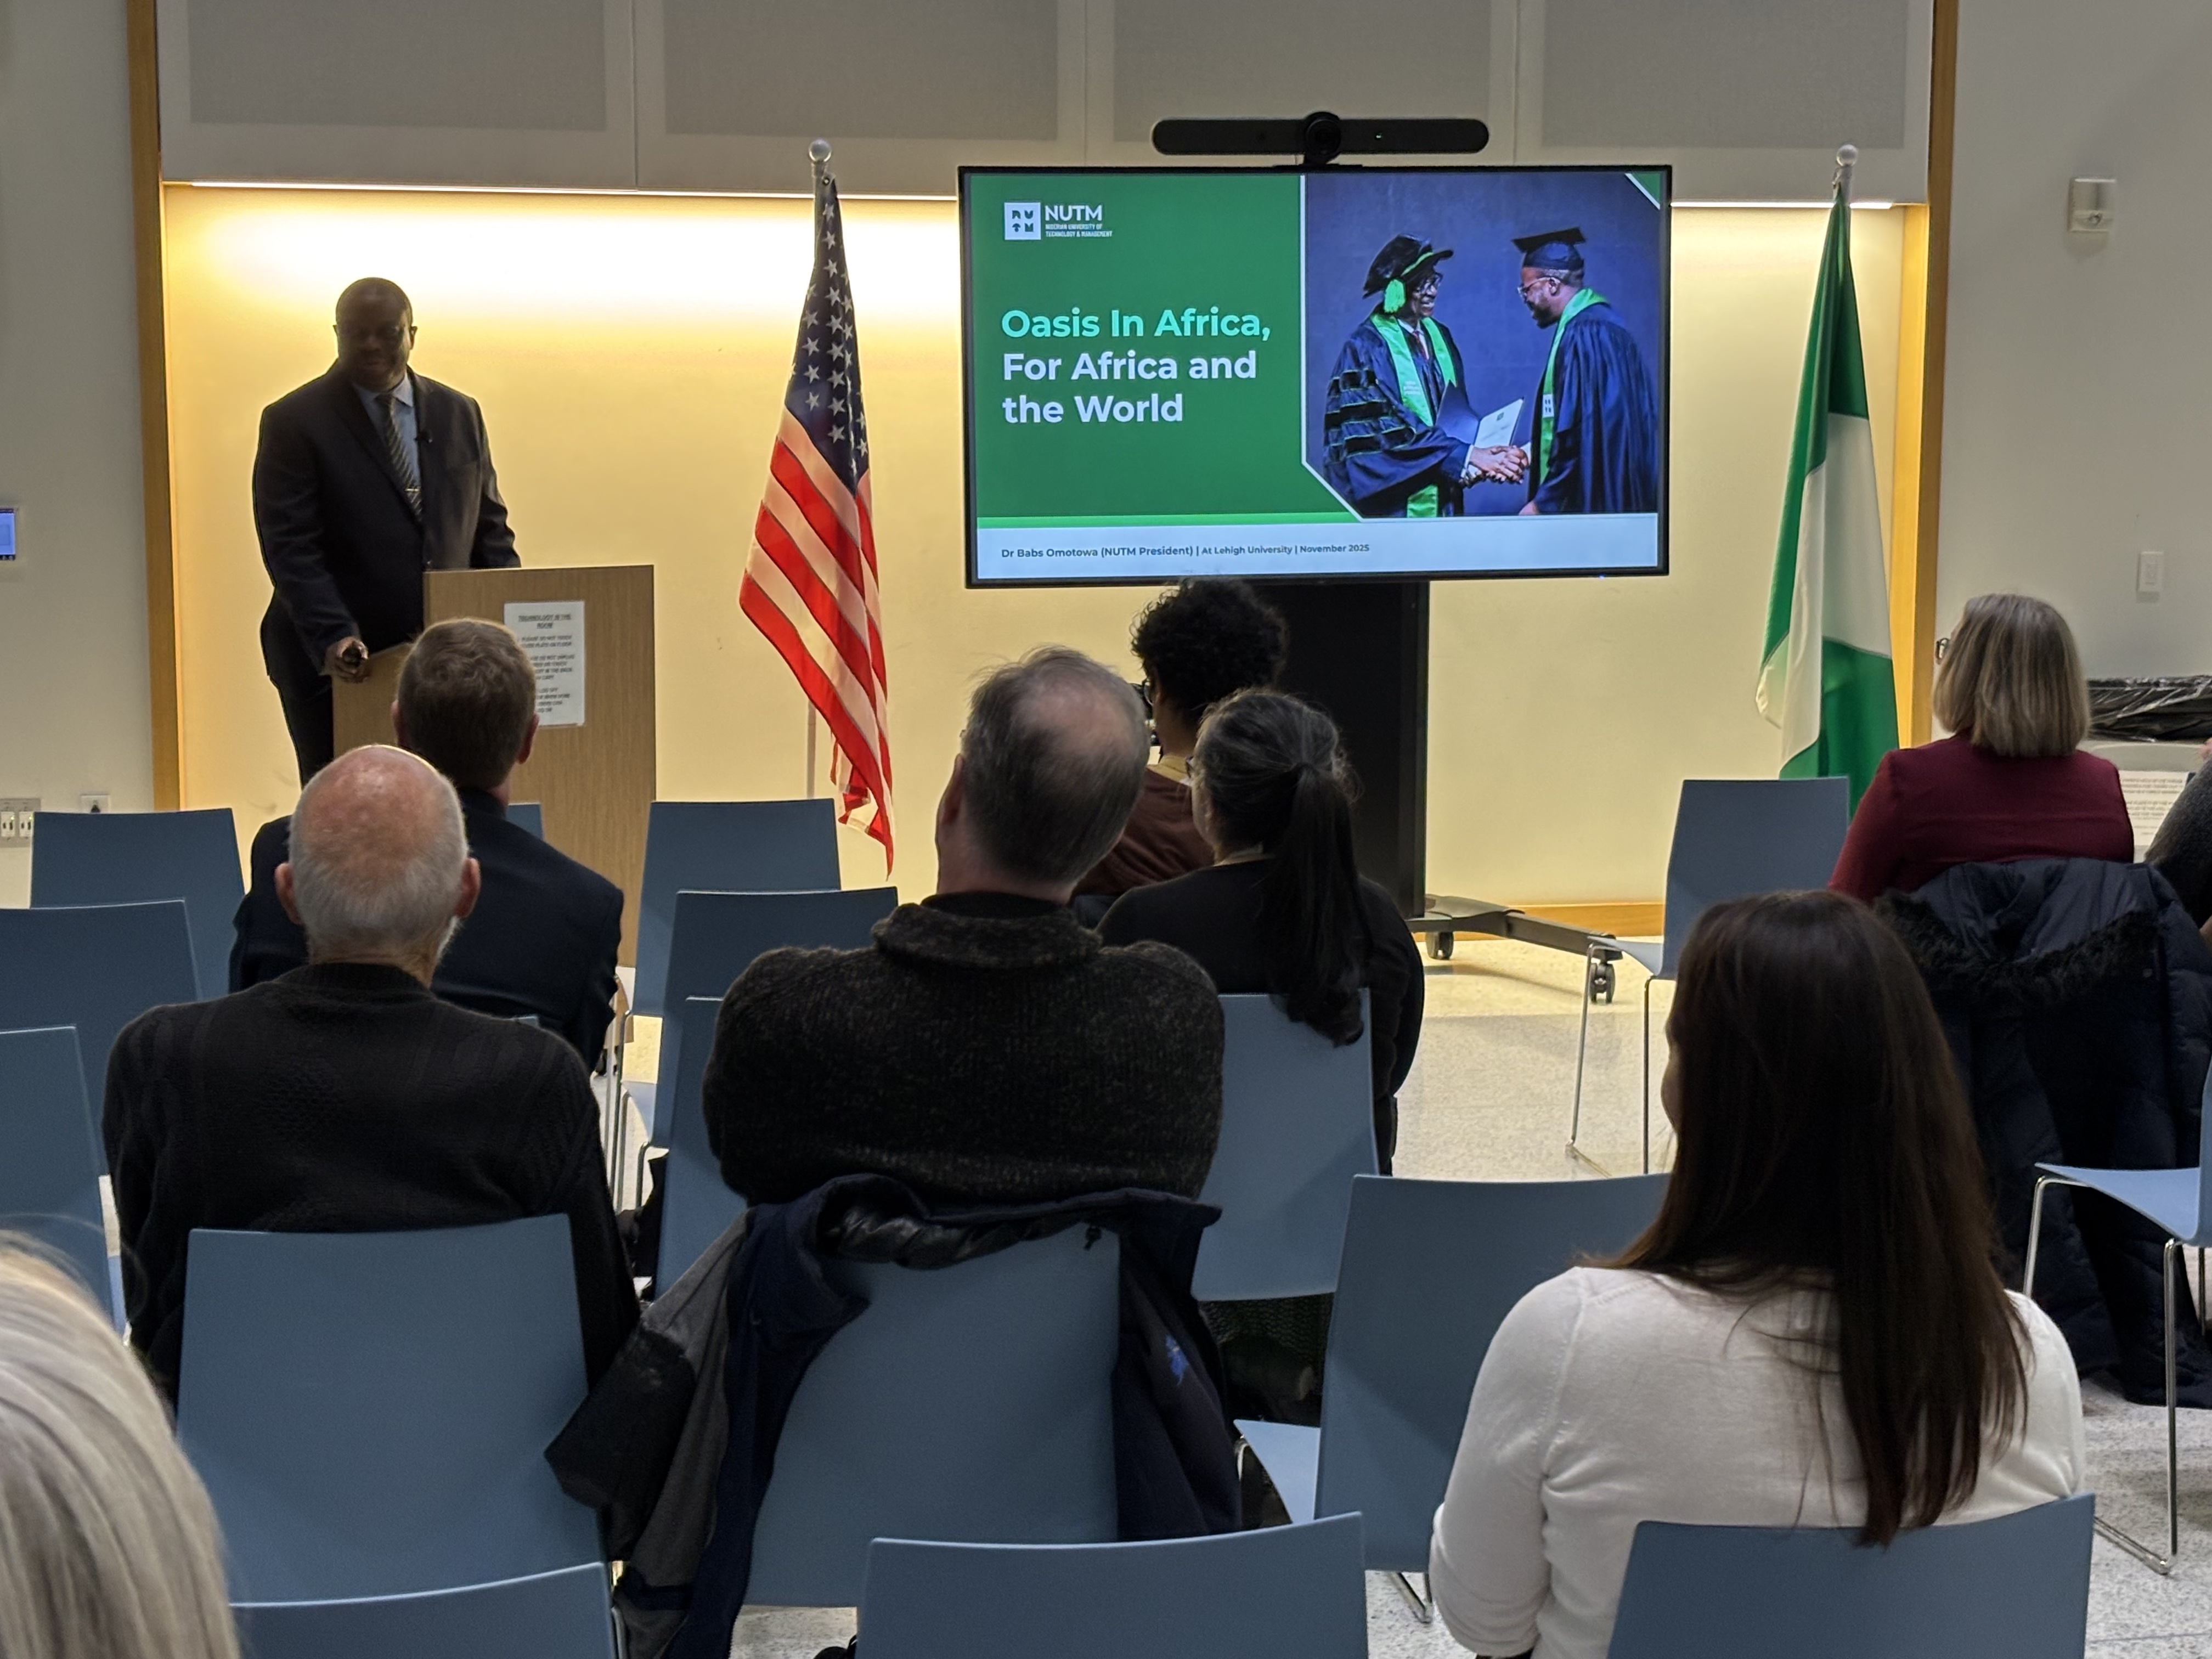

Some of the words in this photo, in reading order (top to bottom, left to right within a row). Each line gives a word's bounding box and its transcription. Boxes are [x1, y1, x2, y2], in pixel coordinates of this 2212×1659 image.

[1045, 205, 1102, 221] NUTM
[1002, 307, 1101, 338] Oasis
[1111, 309, 1144, 337] In
[1154, 306, 1271, 341] Africa,
[1003, 353, 1062, 381] For
[1071, 349, 1177, 380] Africa
[1189, 350, 1256, 379] and
[1002, 394, 1064, 424] the
[1074, 393, 1183, 423] World
[1001, 549, 1014, 557] Dr
[1017, 549, 1043, 557] Babs
[1046, 549, 1098, 557] Omotowa
[1101, 547, 1136, 558] (NUTM
[1139, 546, 1193, 557] President)
[1214, 546, 1245, 556] Lehigh
[1248, 545, 1293, 555] University
[1300, 545, 1346, 553] November
